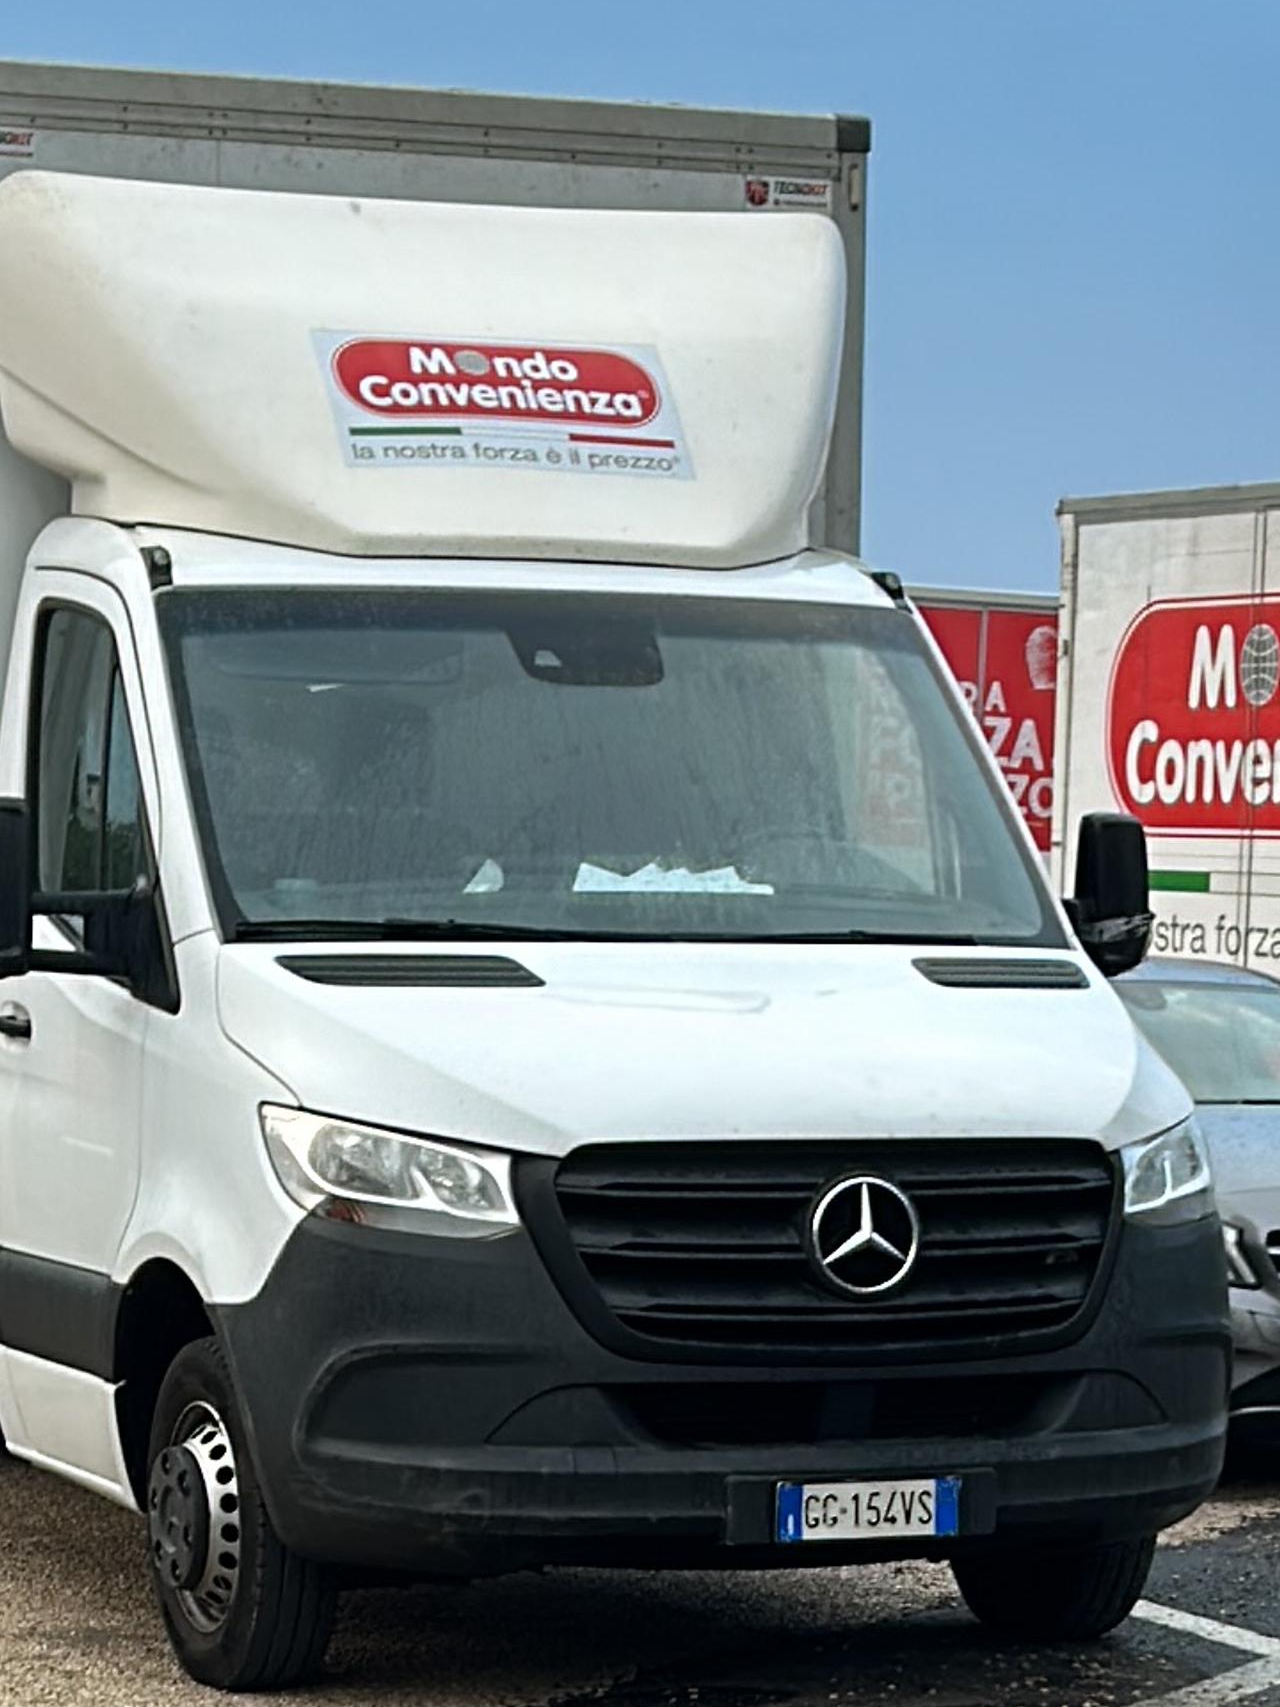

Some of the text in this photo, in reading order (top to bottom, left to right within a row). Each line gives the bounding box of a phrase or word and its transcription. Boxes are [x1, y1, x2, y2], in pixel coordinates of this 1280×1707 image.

[350, 442, 375, 460] la
[383, 442, 467, 461] nostra
[473, 442, 539, 463] forza
[545, 442, 562, 465] è
[569, 445, 582, 466] il
